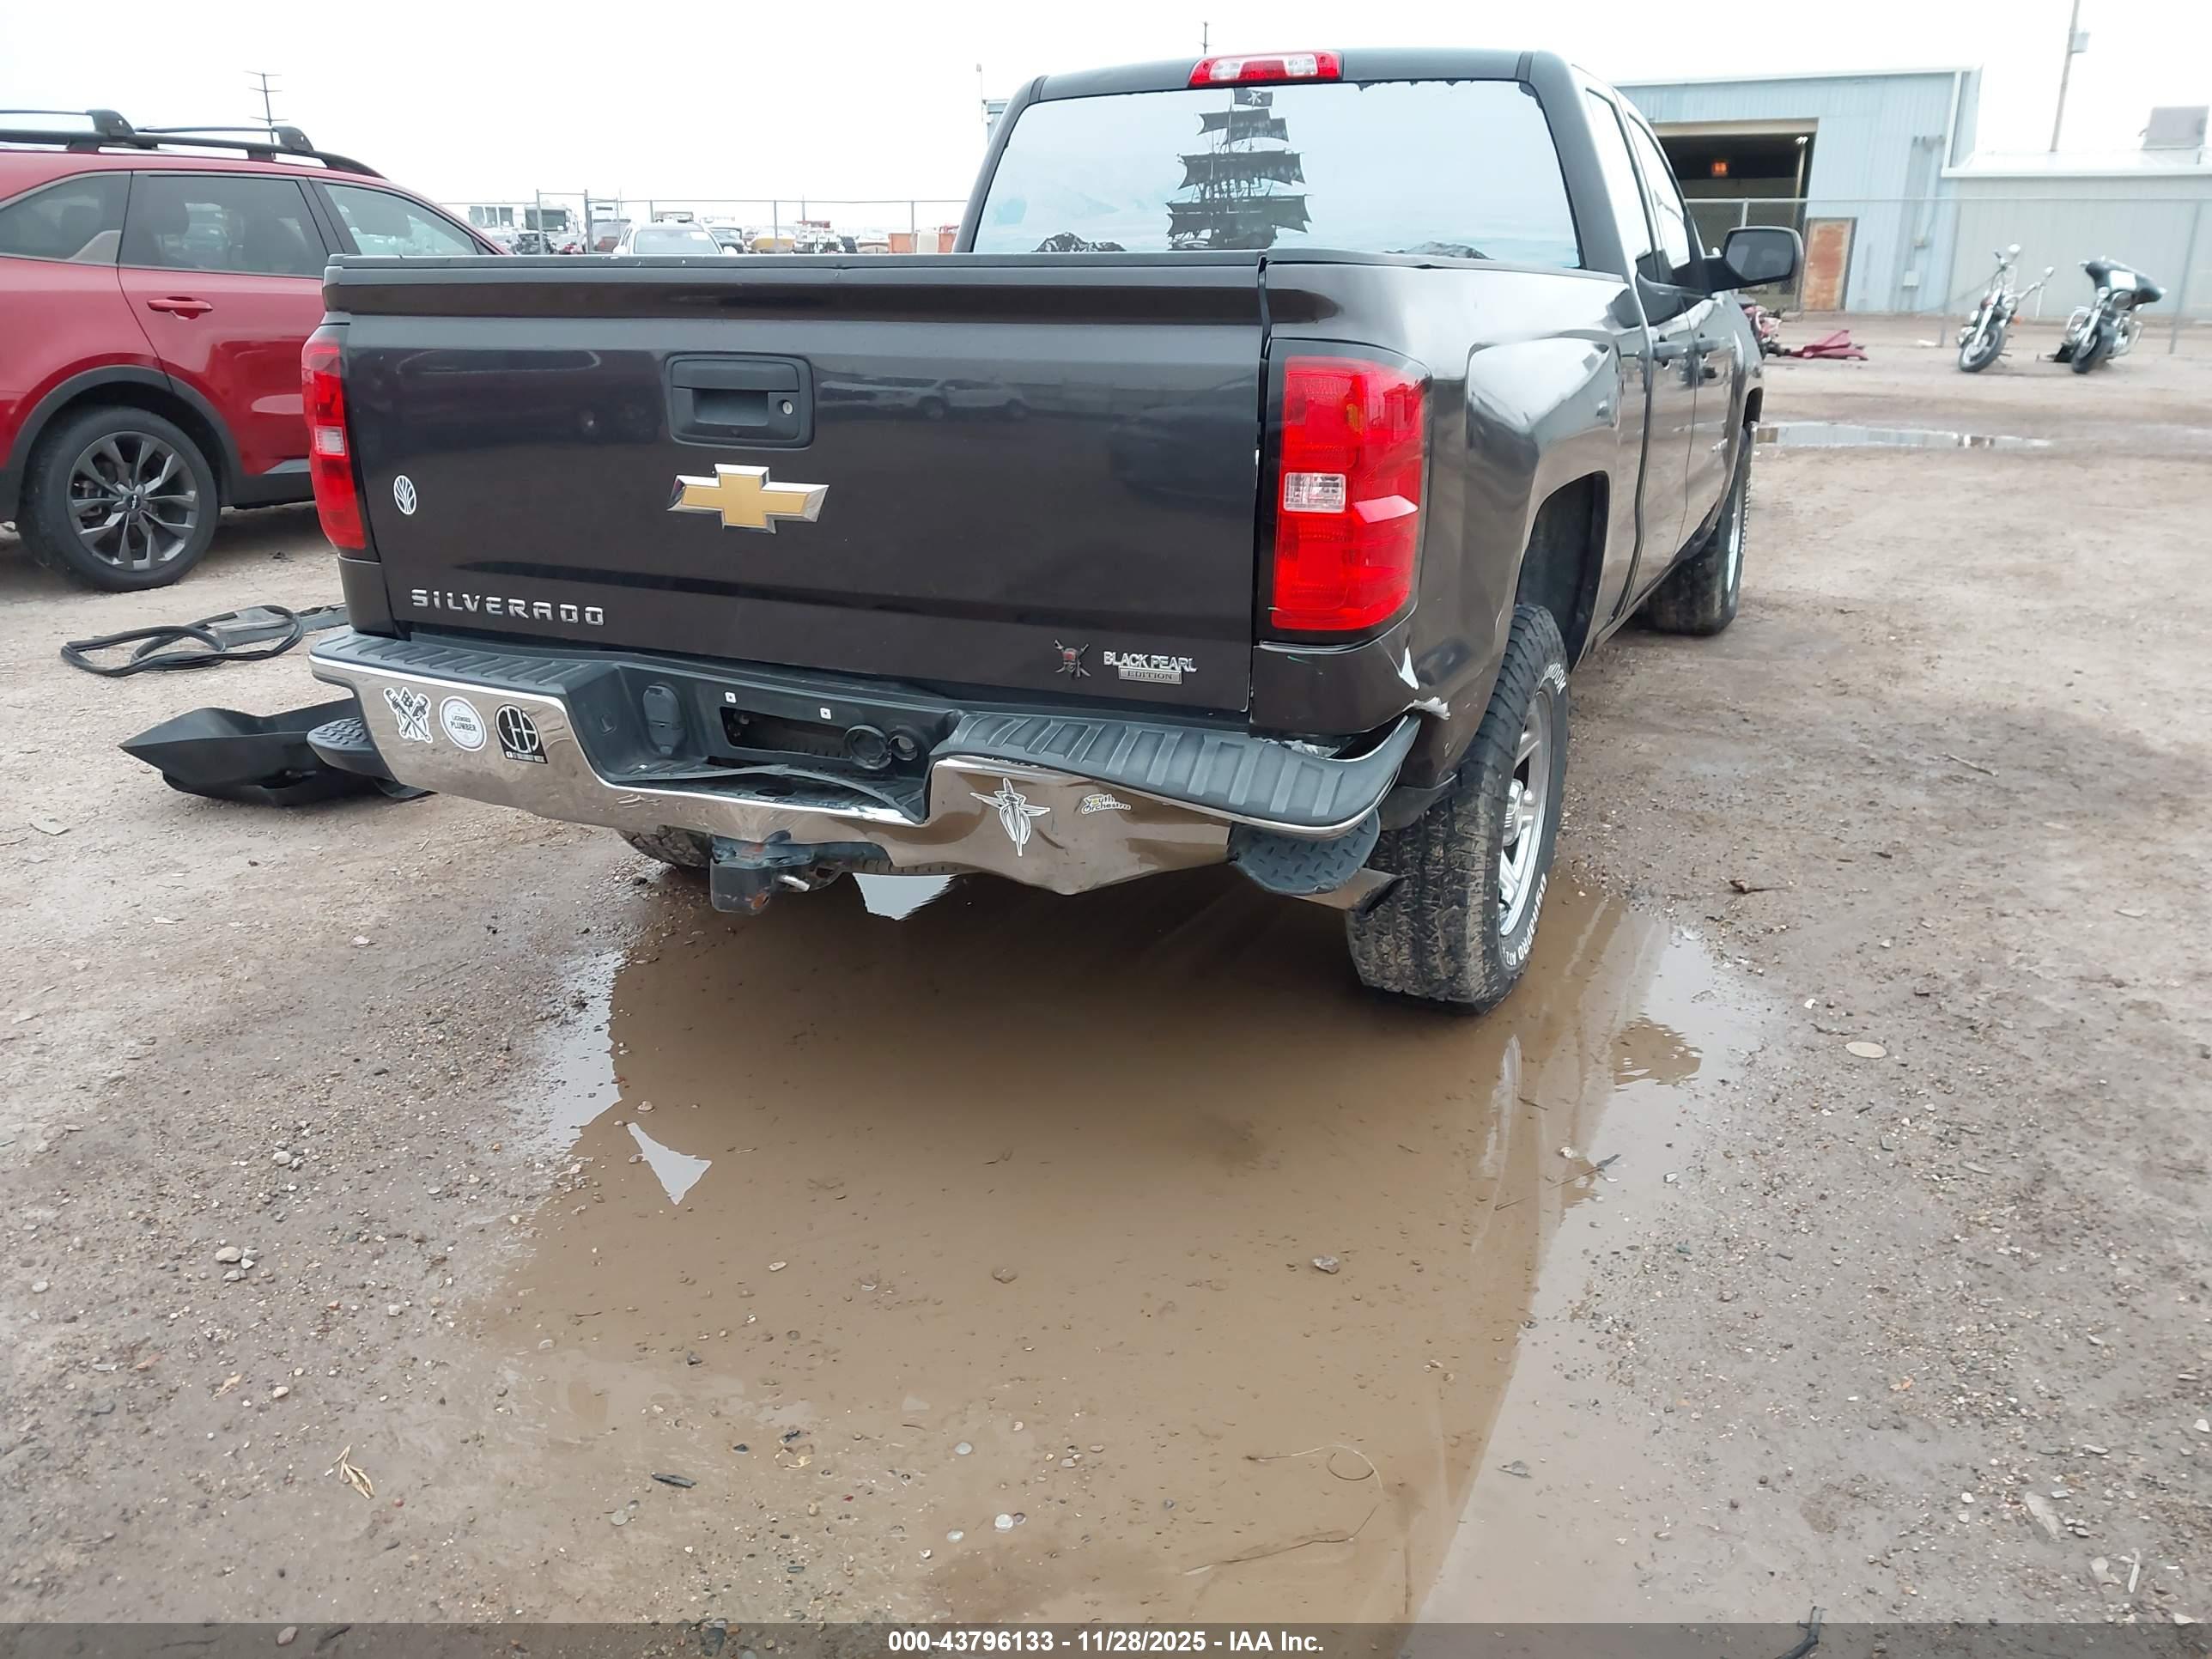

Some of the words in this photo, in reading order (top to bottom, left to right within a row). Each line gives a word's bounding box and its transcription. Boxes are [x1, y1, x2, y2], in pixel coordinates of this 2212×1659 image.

[410, 588, 605, 626] SILVERADO
[1103, 651, 1148, 669] BLACK
[1151, 654, 1198, 673] PEARL
[1127, 671, 1173, 681] EDITION
[450, 720, 477, 732] PLUMBER
[1083, 799, 1132, 814] Orchestra
